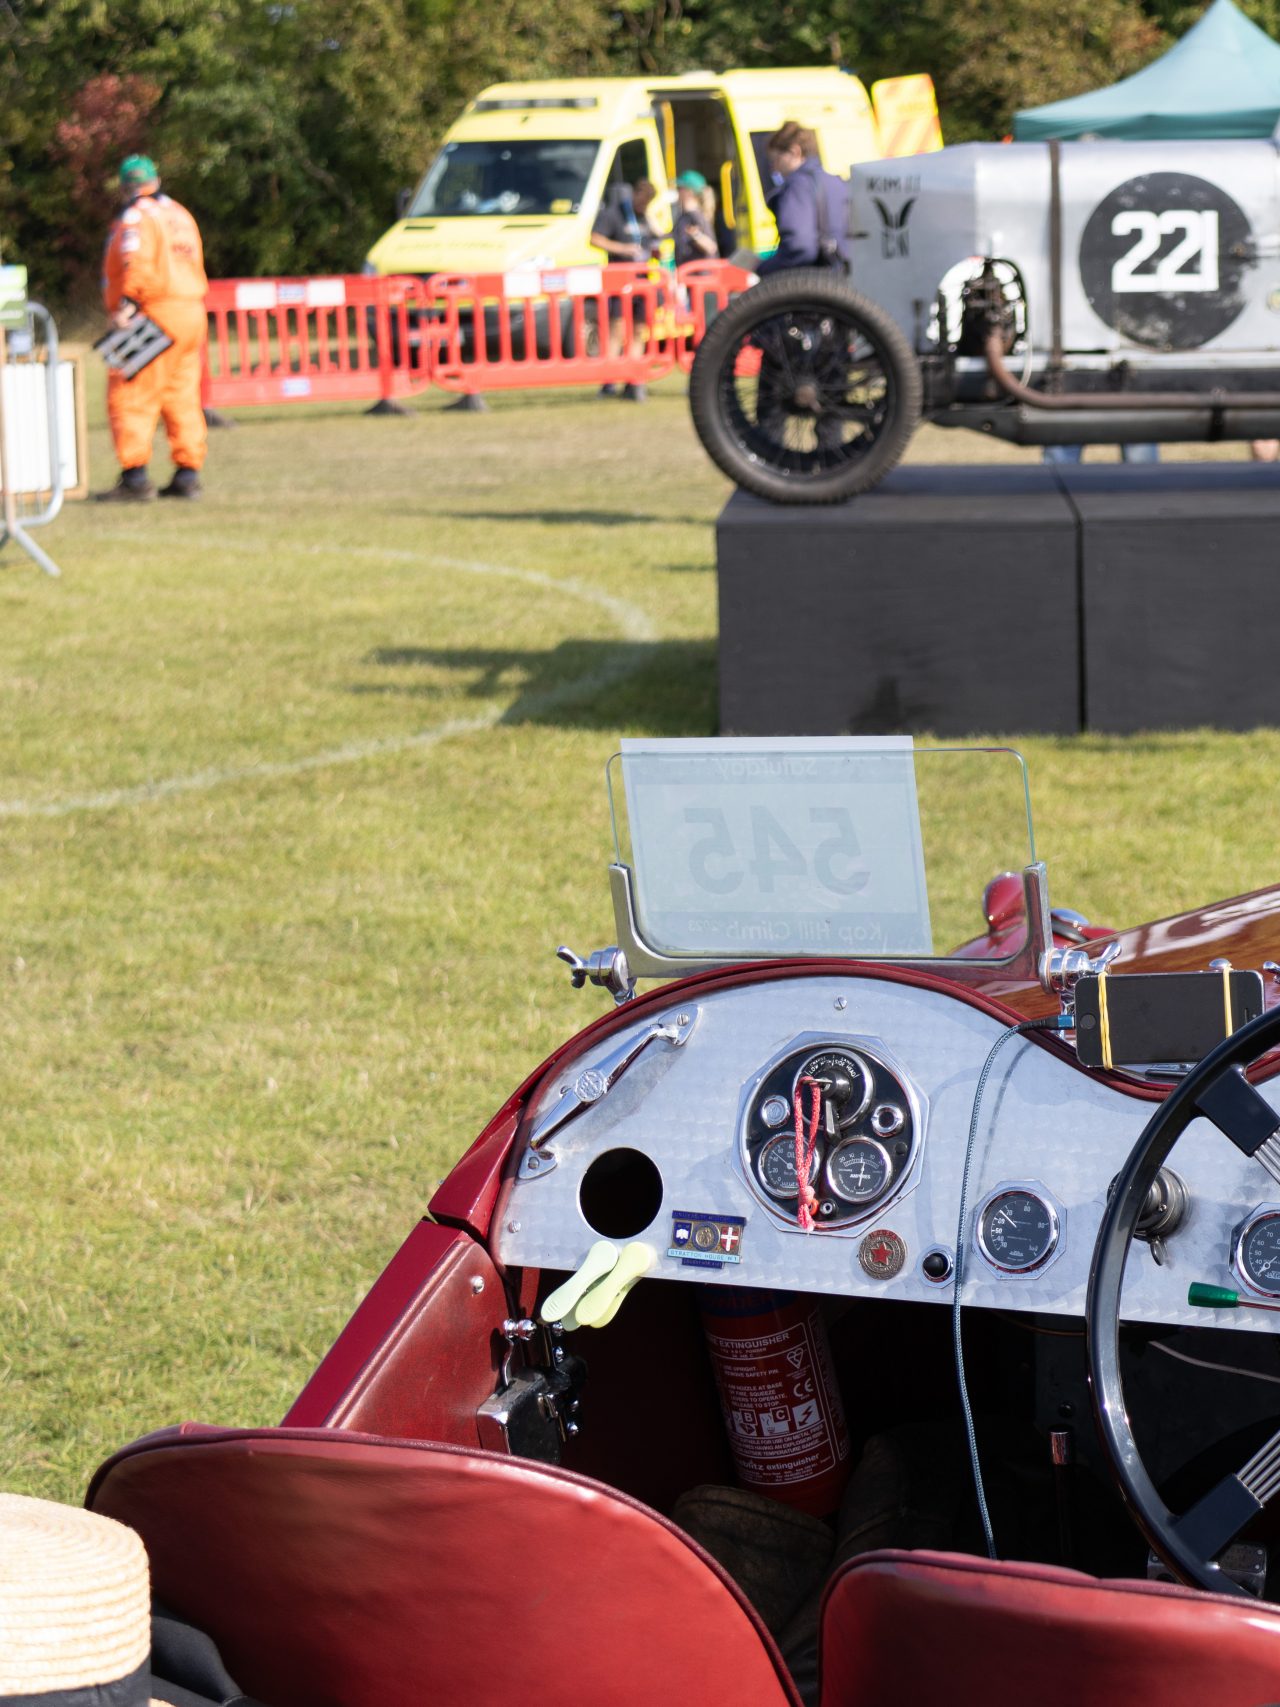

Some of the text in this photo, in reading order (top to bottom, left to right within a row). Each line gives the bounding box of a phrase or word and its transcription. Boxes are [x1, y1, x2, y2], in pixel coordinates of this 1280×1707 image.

[1111, 209, 1219, 293] 221
[720, 1332, 790, 1350] EXTINGUISHER
[749, 1389, 776, 1397] SQUEEZE
[793, 1377, 814, 1397] CE
[744, 1412, 753, 1420] B
[775, 1410, 785, 1420] C
[763, 1446, 801, 1456] TEMPERATURE
[766, 1453, 820, 1471] extinguisher
